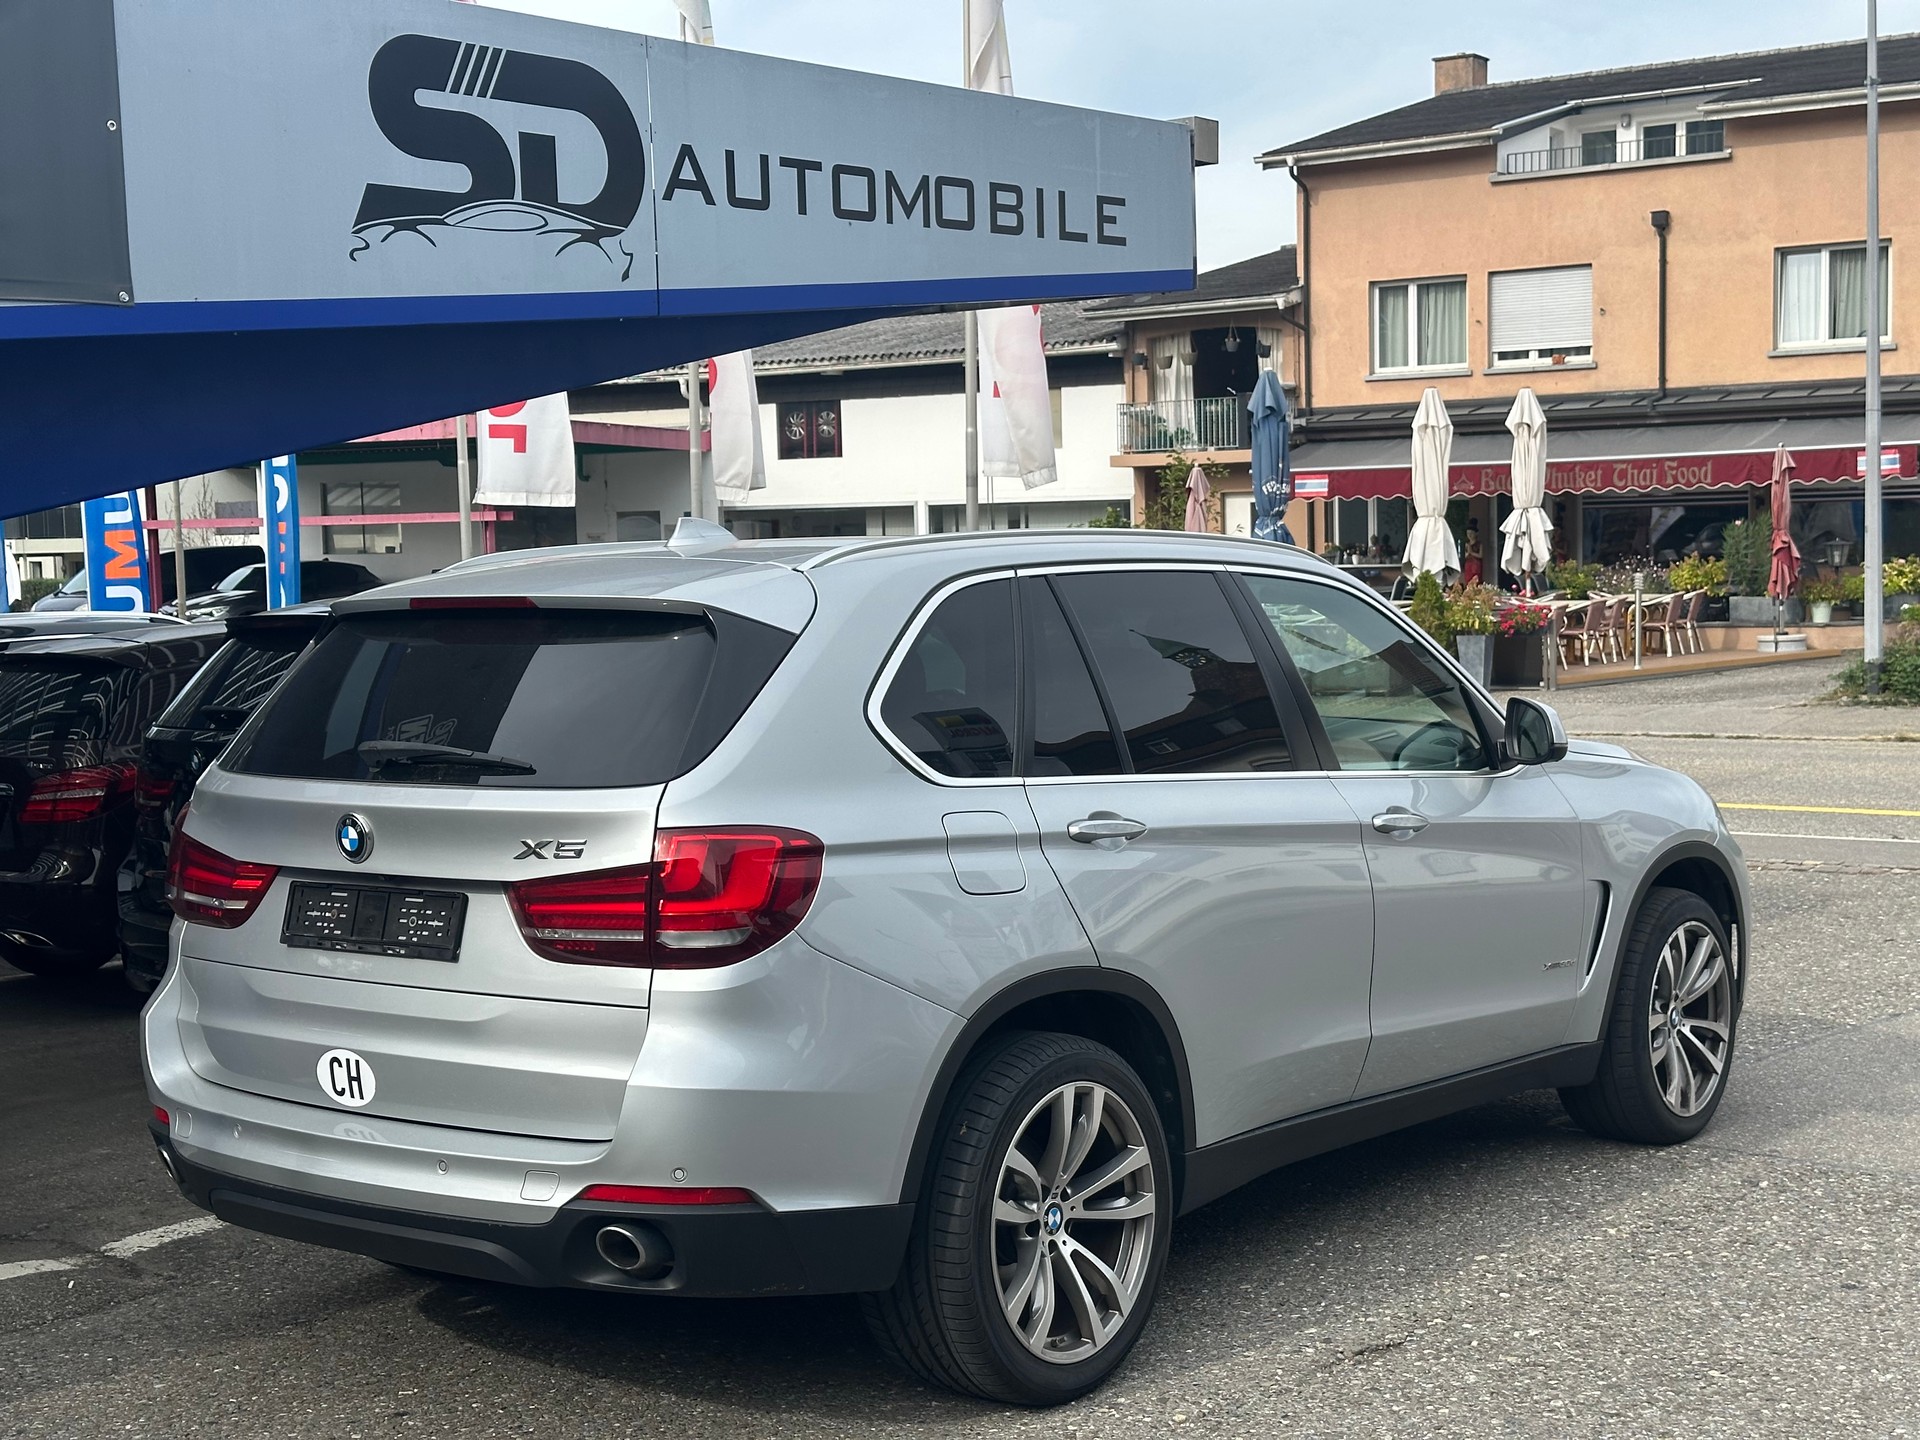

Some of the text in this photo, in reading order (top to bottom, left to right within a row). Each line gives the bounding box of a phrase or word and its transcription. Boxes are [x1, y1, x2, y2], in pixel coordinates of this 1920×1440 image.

[352, 33, 1127, 246] SD AUTOMOBILE
[1546, 464, 1603, 489] huket
[1612, 462, 1658, 487] Thai
[1664, 460, 1713, 485] Food
[512, 838, 588, 860] X5
[329, 1056, 365, 1101] CH
